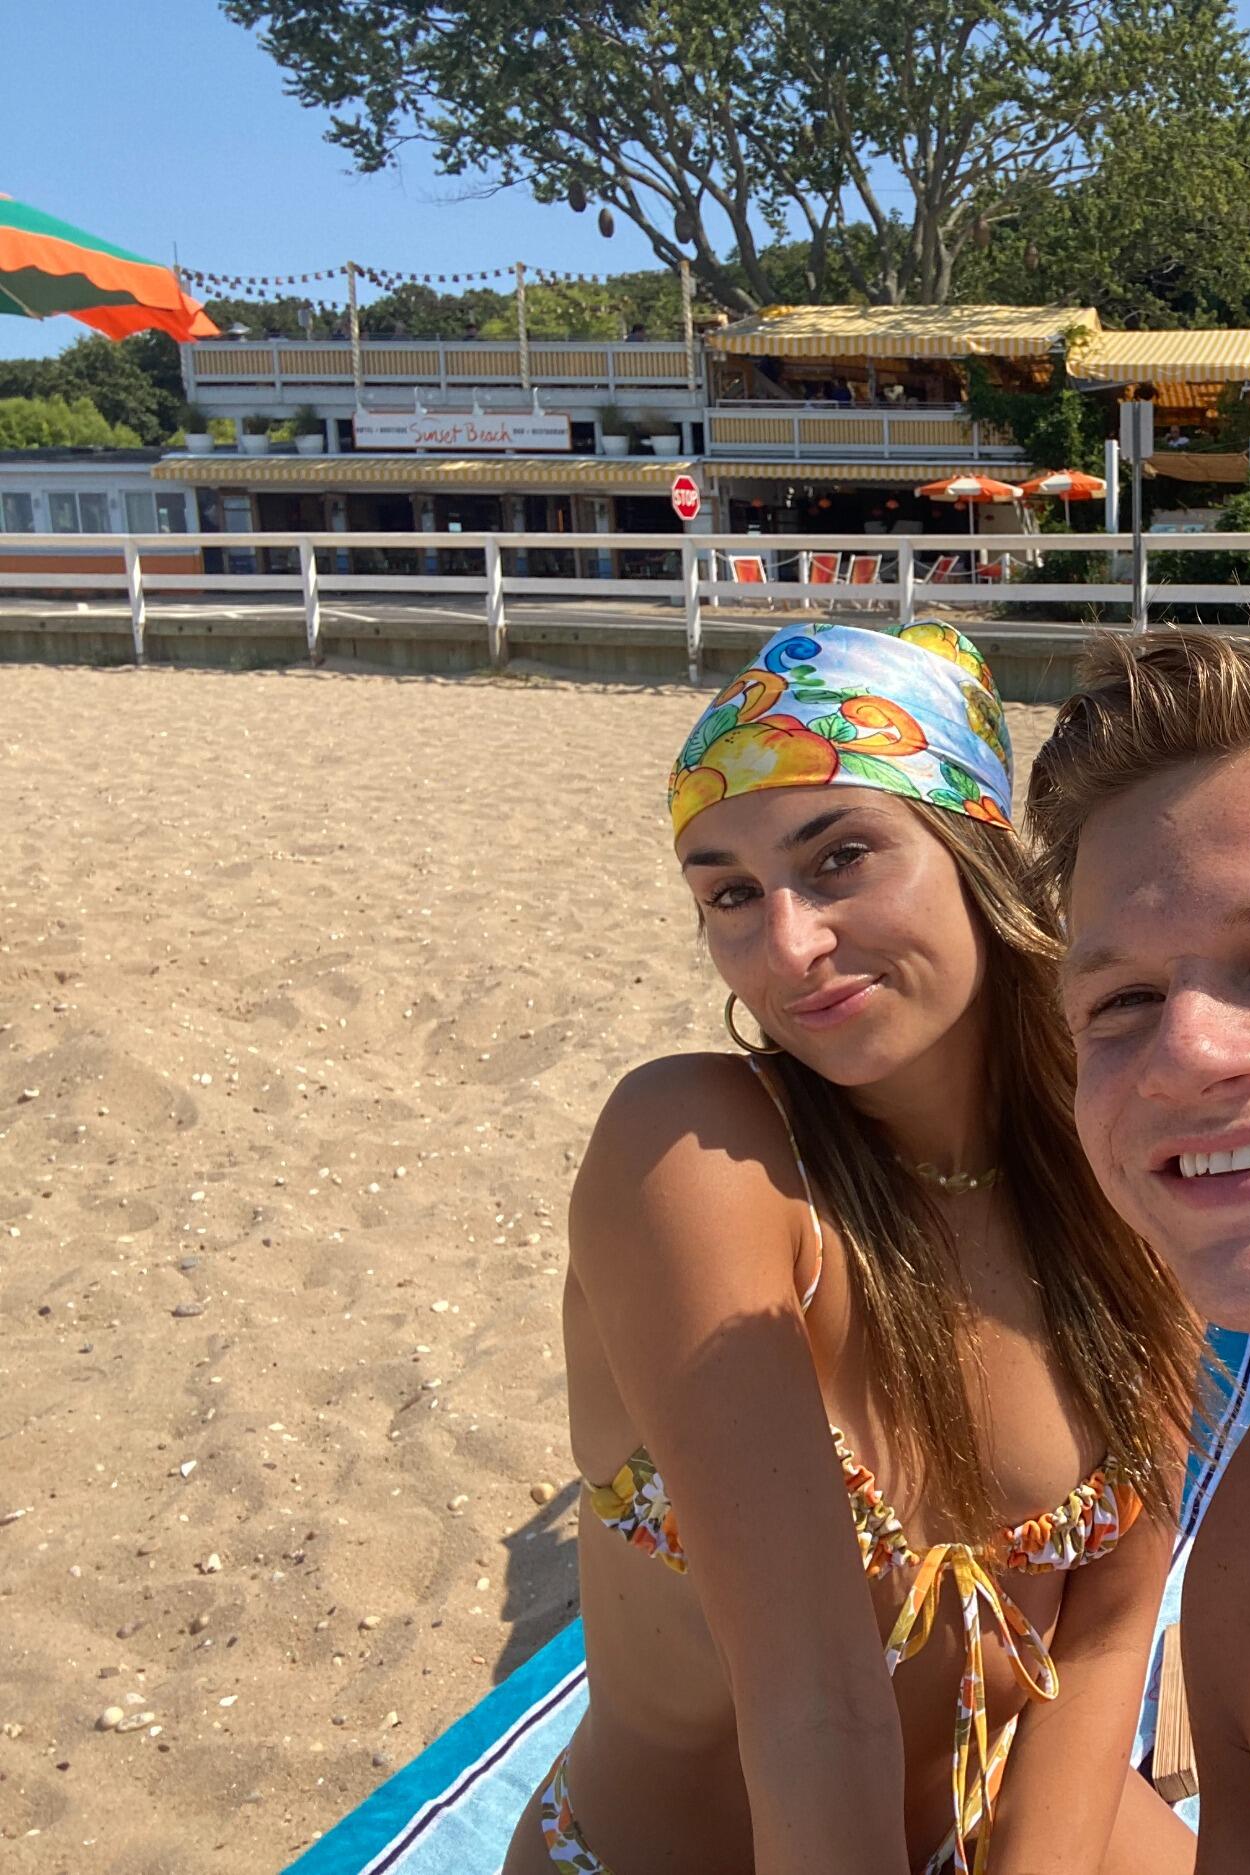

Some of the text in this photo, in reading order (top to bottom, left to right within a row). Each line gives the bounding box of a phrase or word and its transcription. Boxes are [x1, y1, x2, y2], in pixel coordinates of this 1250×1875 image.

[409, 421, 513, 444] Sunset Beach
[674, 489, 698, 506] STOP
